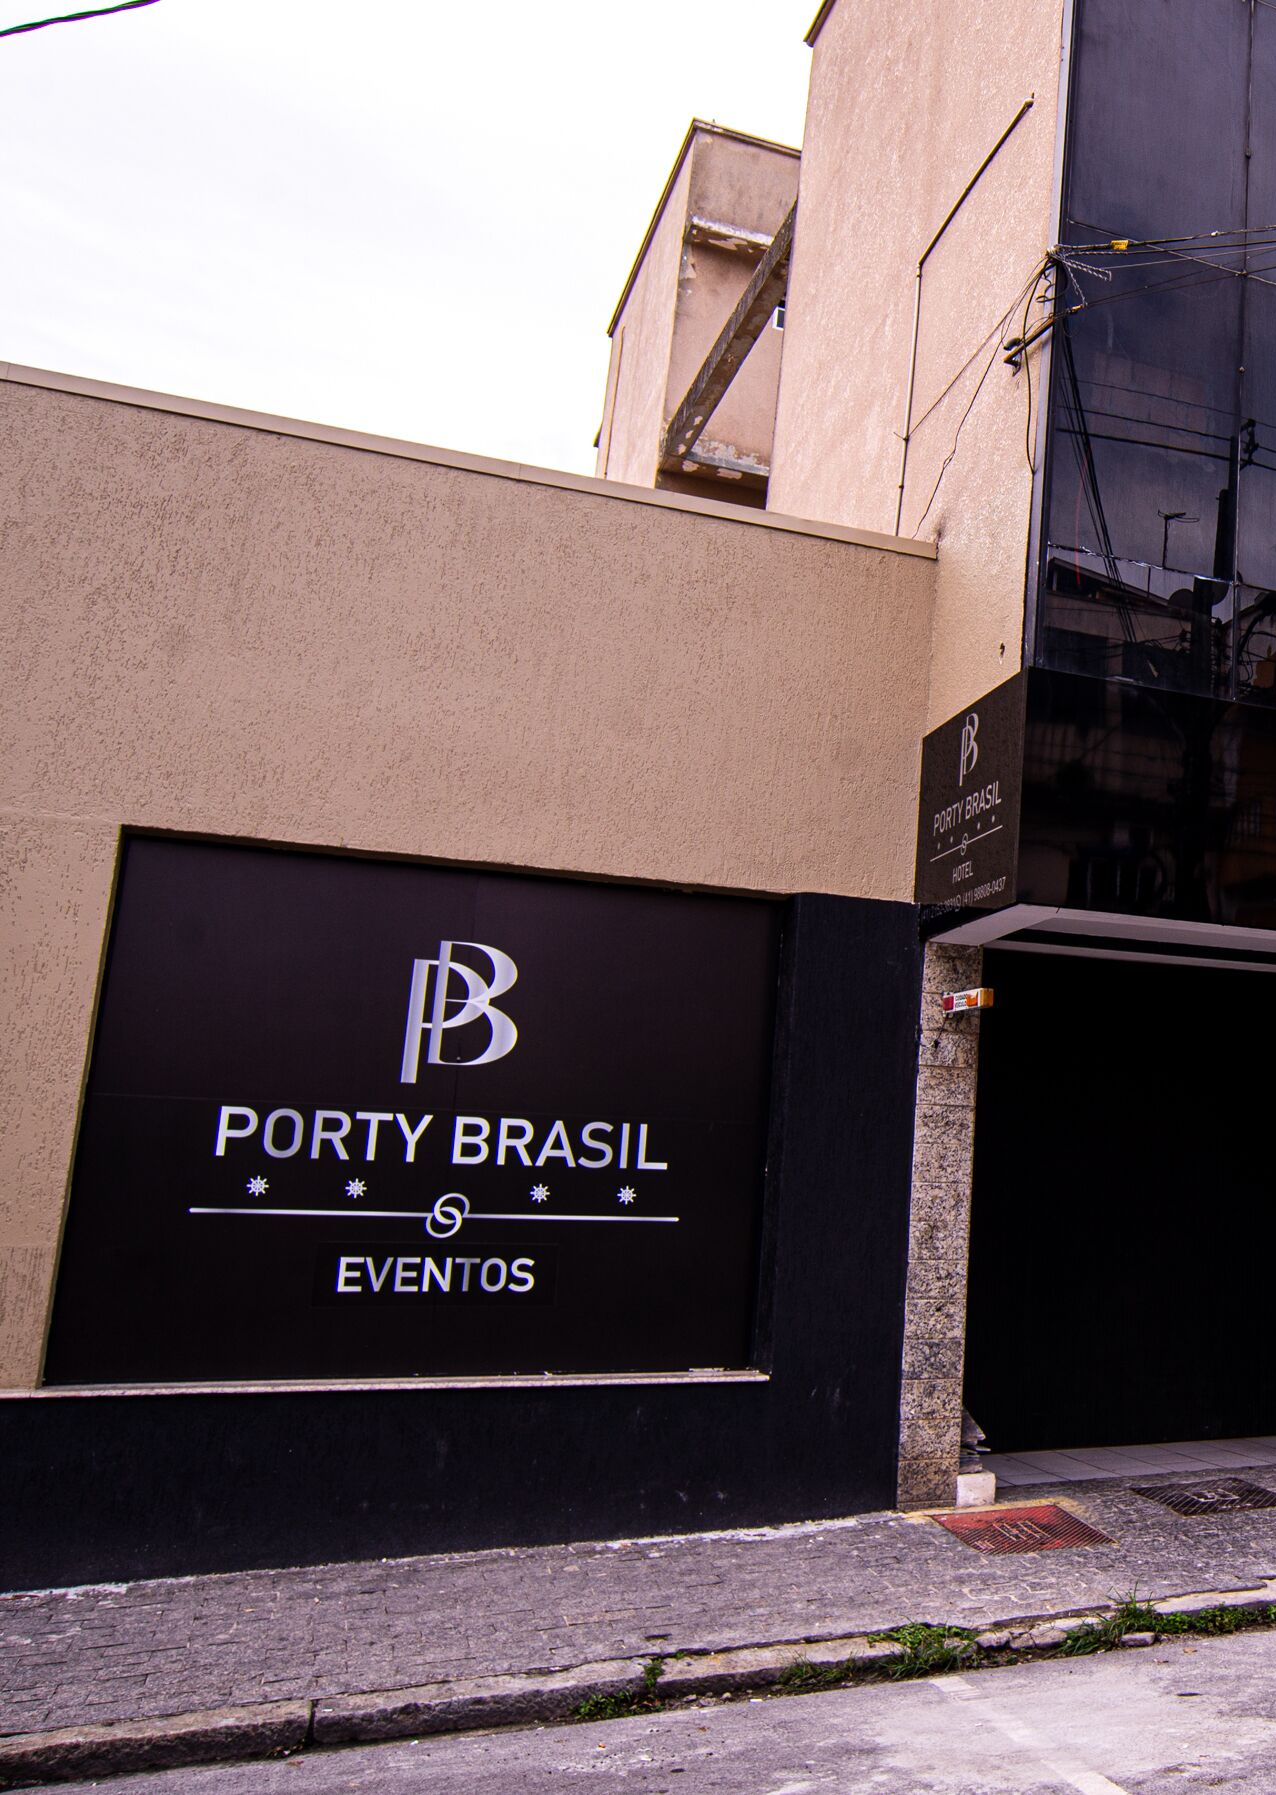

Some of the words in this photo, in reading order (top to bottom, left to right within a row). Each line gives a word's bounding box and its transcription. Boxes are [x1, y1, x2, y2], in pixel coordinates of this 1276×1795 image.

[933, 800, 964, 837] PORTY
[965, 780, 1002, 820] BRASIL
[952, 860, 974, 884] HOTEL
[214, 1105, 434, 1163] PORTY
[451, 1115, 668, 1171] BRASIL
[336, 1256, 536, 1293] EVENTOS
